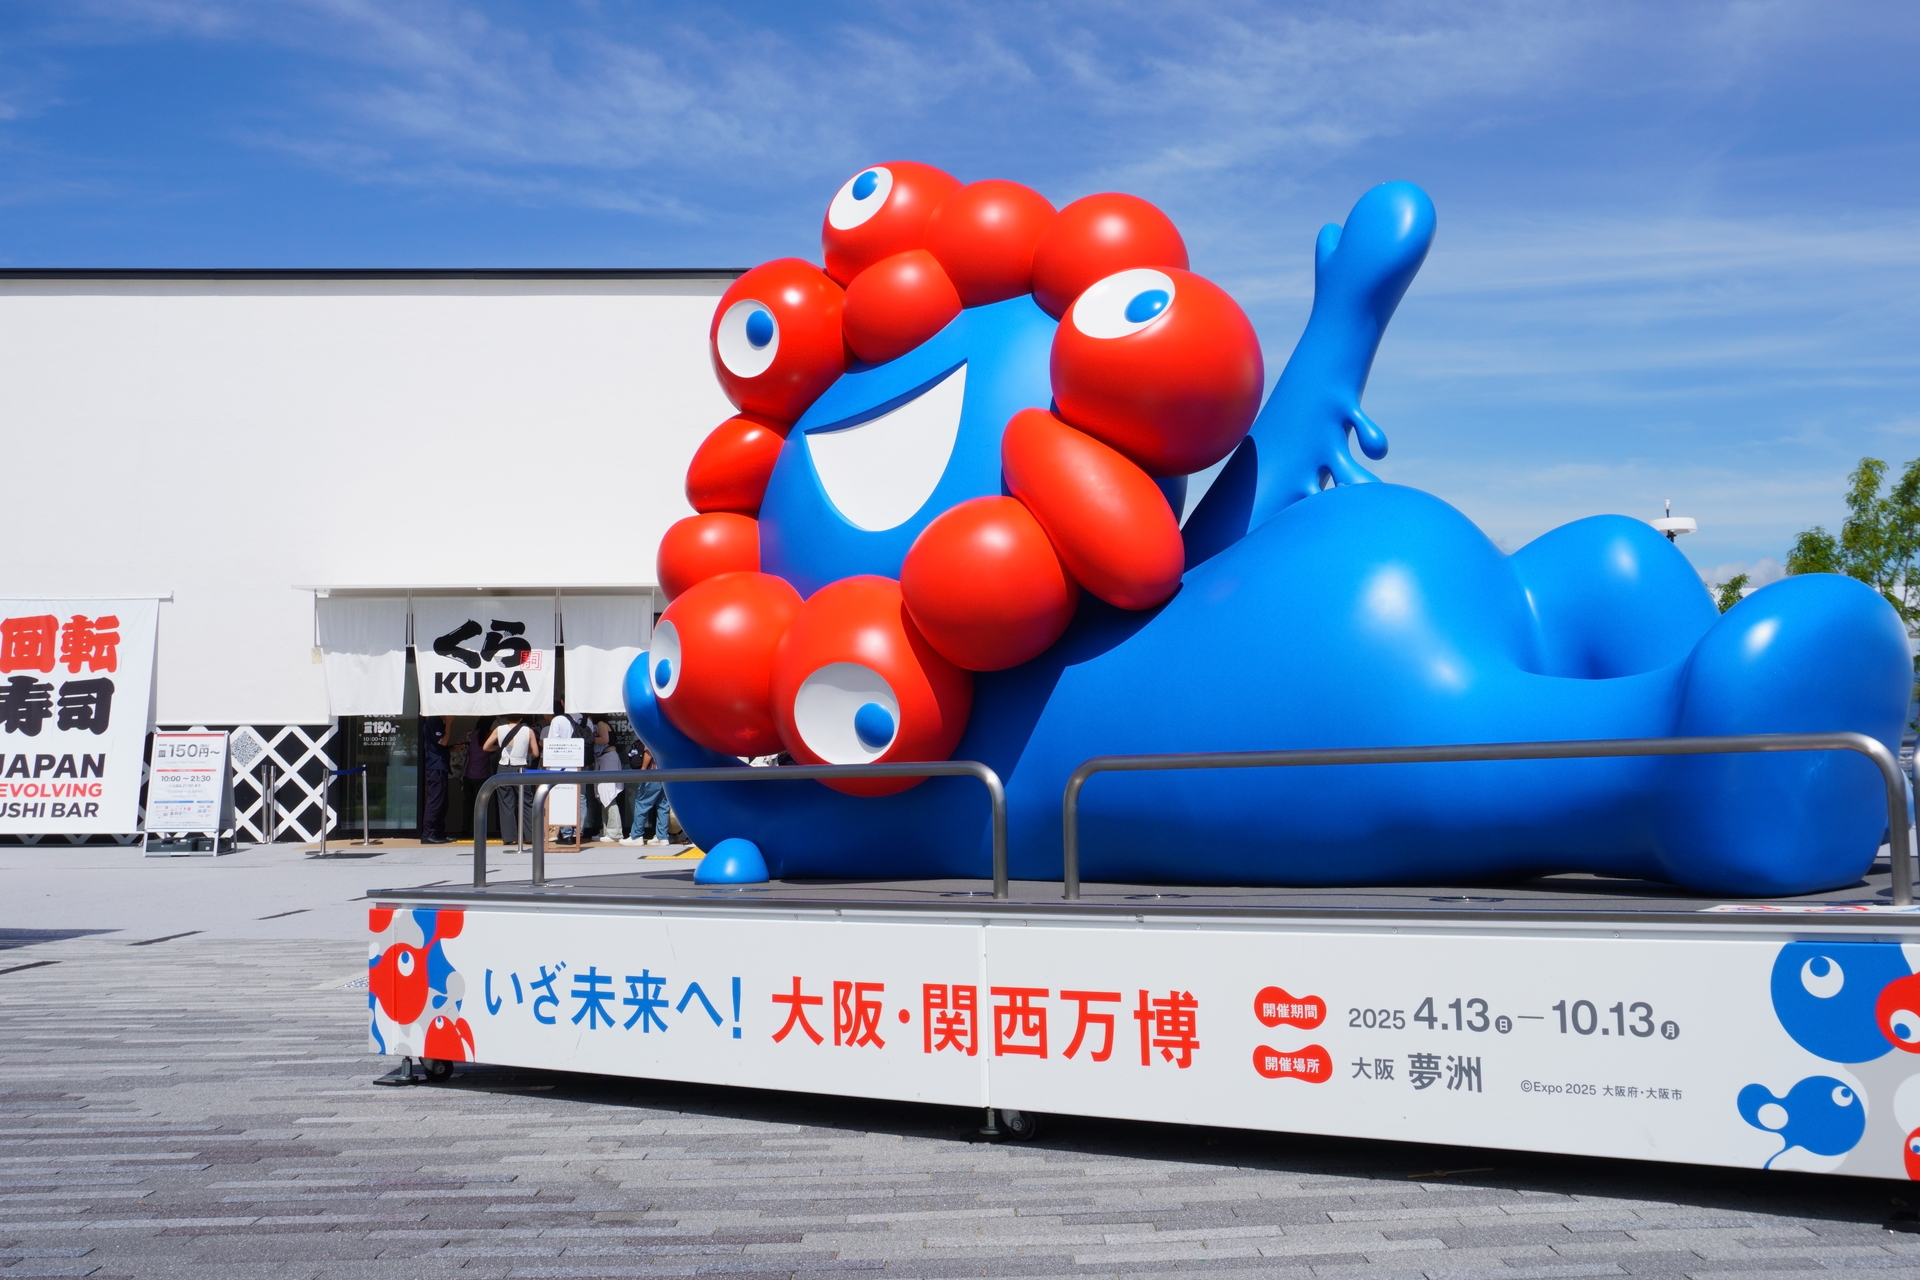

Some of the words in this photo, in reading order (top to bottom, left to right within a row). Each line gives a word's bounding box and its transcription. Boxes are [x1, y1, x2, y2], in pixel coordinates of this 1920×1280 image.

[0, 614, 120, 674] 回転
[433, 619, 532, 669] くら
[434, 671, 531, 694] KURA
[0, 675, 115, 737] 寿司
[0, 783, 102, 798] EVOLVING
[0, 802, 46, 818] USHI
[51, 802, 99, 818] BAR
[484, 961, 742, 1039] いざ未来へ!
[771, 976, 1200, 1069] 大阪・関西万博
[1262, 1002, 1318, 1020] 開催期間
[1348, 1007, 1406, 1030] 2025
[1264, 1056, 1320, 1074] 開催場所
[1351, 1056, 1395, 1081] 大阪
[1407, 1052, 1483, 1093] 夢洲
[1565, 1083, 1597, 1096] 2025
[1602, 1084, 1683, 1101] 大阪府・大阪市
